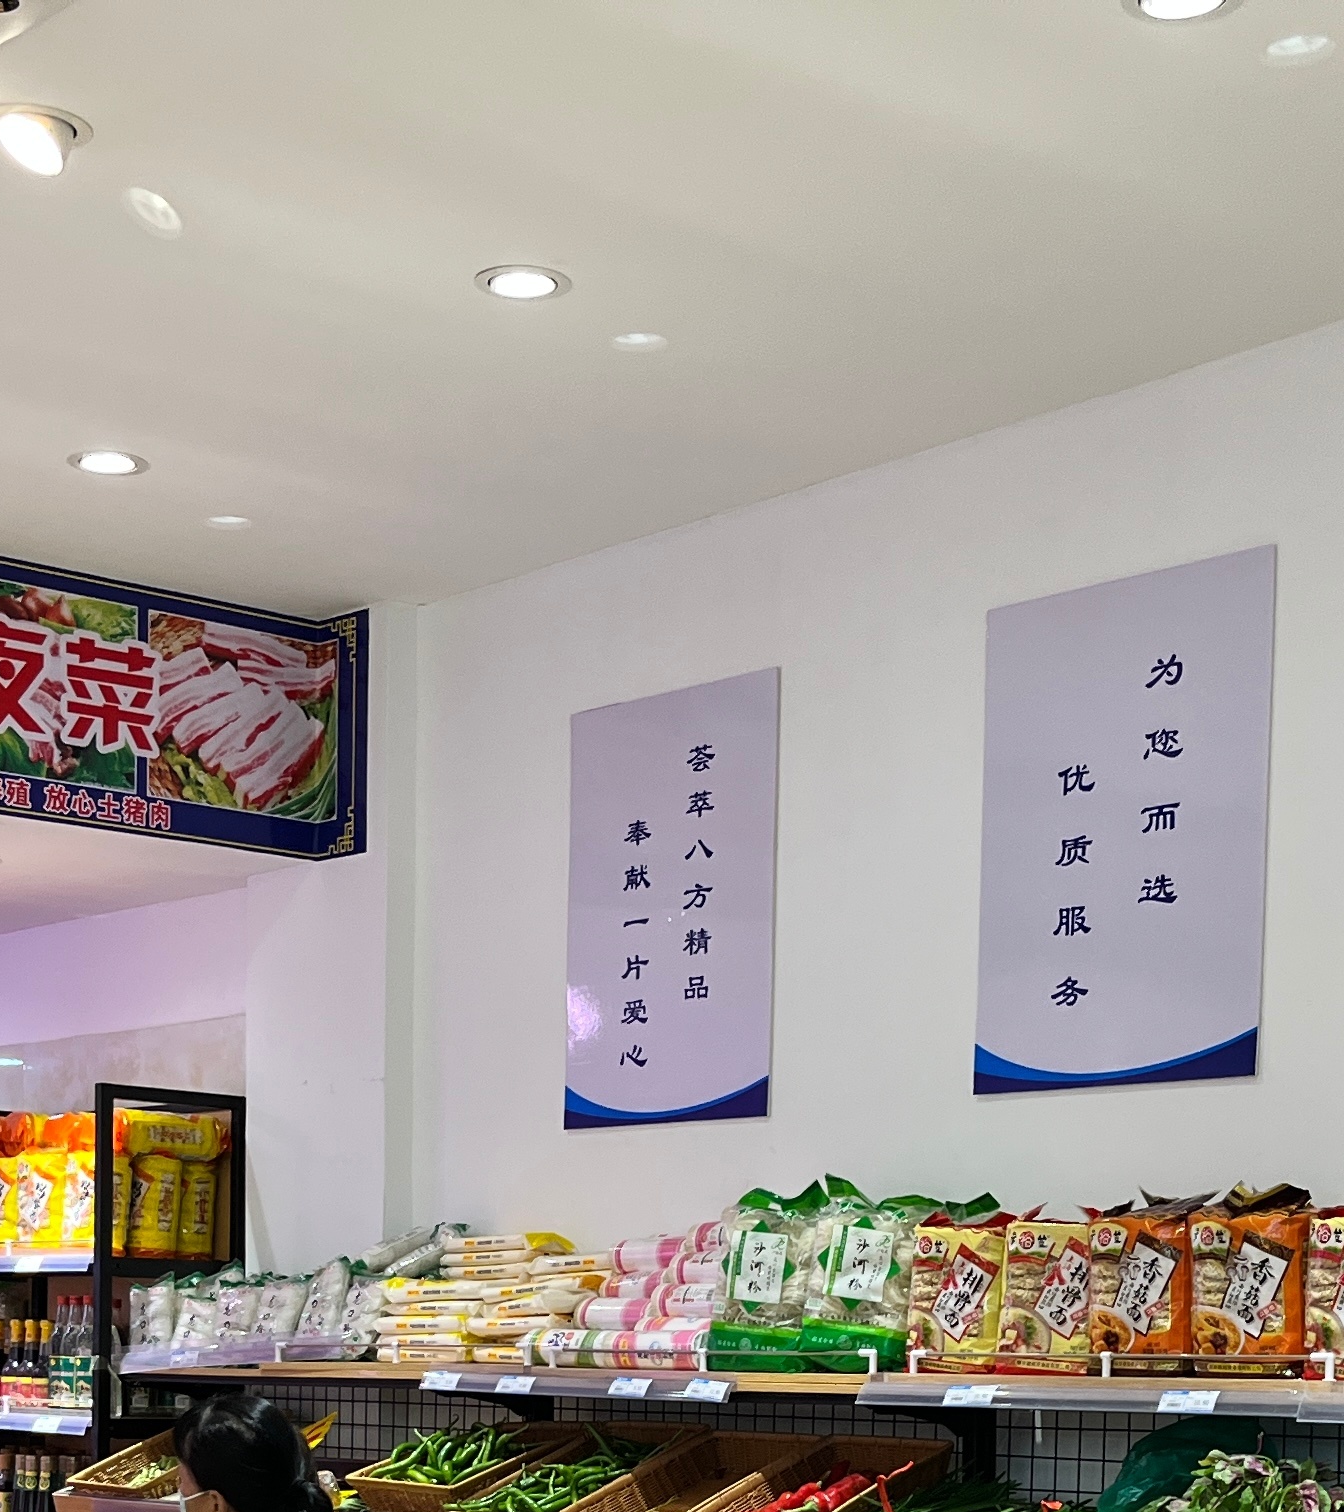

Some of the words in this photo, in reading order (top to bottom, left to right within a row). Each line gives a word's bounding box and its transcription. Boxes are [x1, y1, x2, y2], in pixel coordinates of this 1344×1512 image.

[44, 784, 172, 831] 放心土猪肉
[1136, 653, 1184, 905] 为您而选
[619, 818, 651, 1070] 奉献一片爱心
[682, 743, 716, 1002] 荟萃八方精品
[1050, 763, 1095, 1008] 优质服务
[944, 1267, 983, 1328] 排骨面
[1127, 1257, 1163, 1321] 香菇面
[1237, 1258, 1276, 1324] 香菇面
